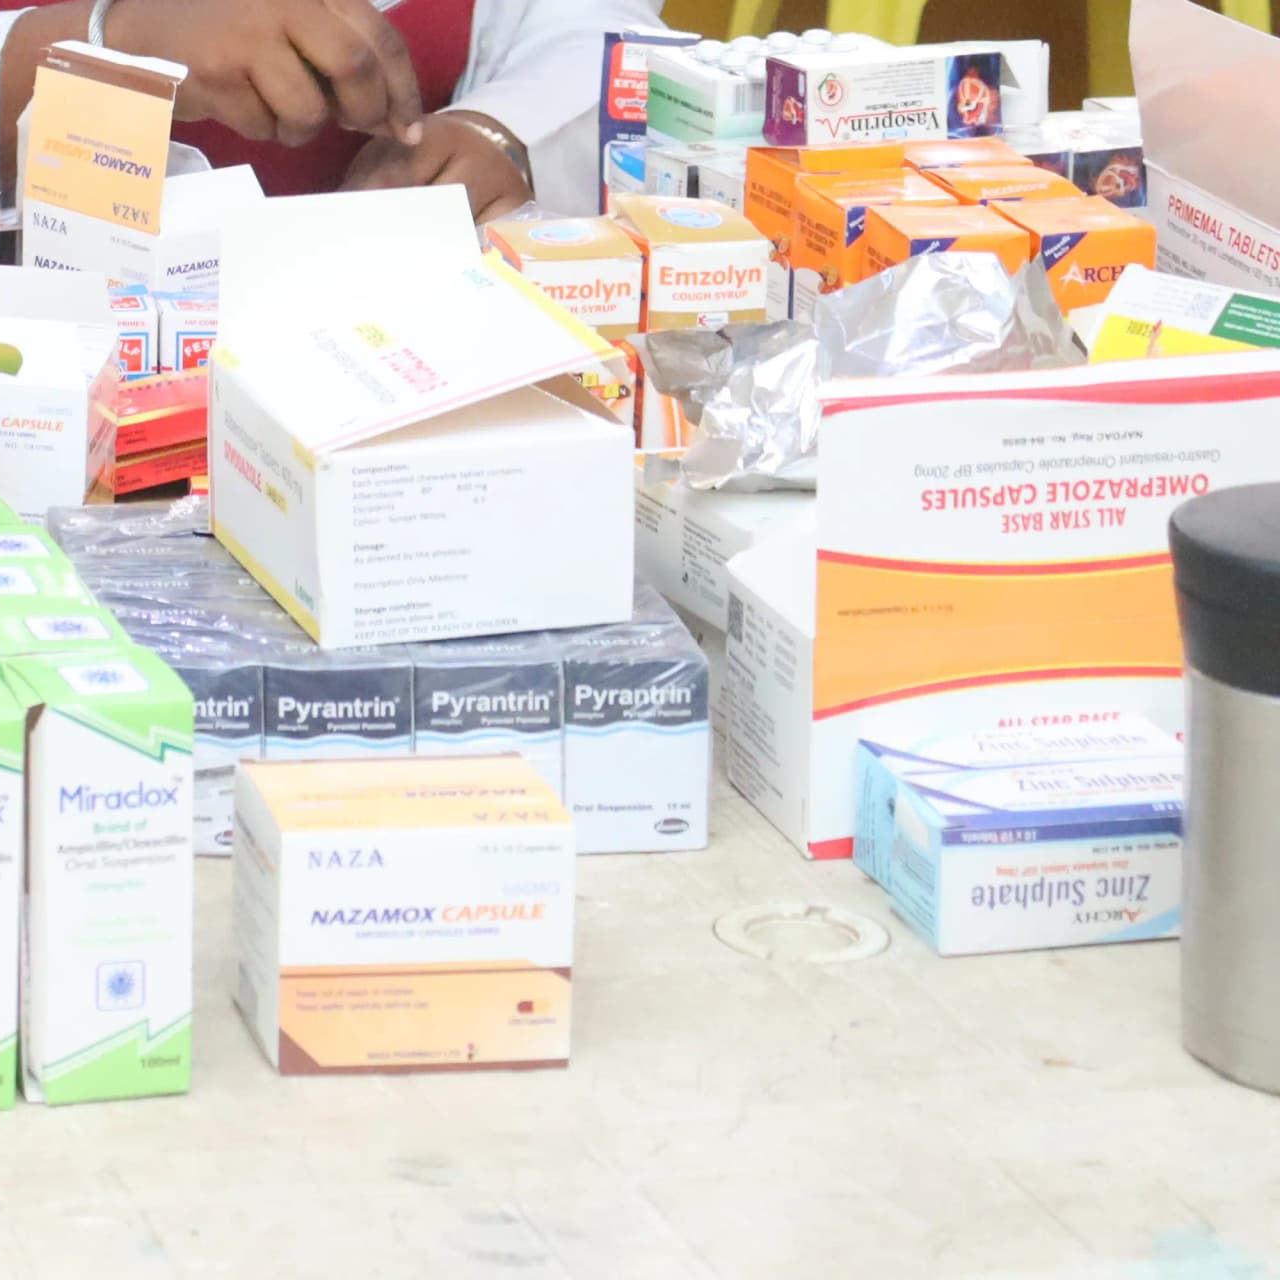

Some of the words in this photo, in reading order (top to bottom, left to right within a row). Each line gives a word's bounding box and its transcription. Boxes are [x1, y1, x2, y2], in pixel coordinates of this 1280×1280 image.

[851, 109, 940, 135] Vasoprin
[92, 152, 153, 178] NAZAMOX
[33, 211, 68, 235] NAZA
[111, 200, 149, 224] NAZA
[1168, 194, 1224, 243] PRIMEMAL
[1228, 226, 1280, 271] TABLETS
[166, 258, 220, 276] NAZAMOX
[658, 264, 762, 288] Emzolyn
[532, 278, 632, 302] mzolyn
[671, 291, 712, 302] COUGH
[713, 289, 749, 300] SYRUP
[581, 304, 617, 314] SYRUP
[0, 415, 65, 433] CAPSULE
[976, 458, 1035, 474] Capsules
[1038, 453, 1116, 471] Omeprazole
[1120, 448, 1222, 467] Gastro-resistant
[914, 463, 951, 479] 20mg
[954, 464, 972, 477] BP
[921, 483, 1038, 512] CAPSULES
[1046, 473, 1209, 503] OMEPRAZOLE
[1001, 511, 1044, 534] BASE
[1049, 508, 1090, 531] STAR
[1097, 507, 1127, 527] ALL
[193, 695, 249, 717] ntrin
[278, 696, 397, 723] Pyrantrin
[431, 690, 550, 718] Pyrantrin
[574, 684, 691, 710] Pyrantrin
[307, 847, 385, 870] NAZA
[971, 877, 1086, 911] Sulphate
[1095, 875, 1152, 902] Zinc
[310, 905, 437, 926] NAZAMOX
[441, 902, 546, 922] CAPSULE
[1072, 907, 1141, 925] ARCHY
